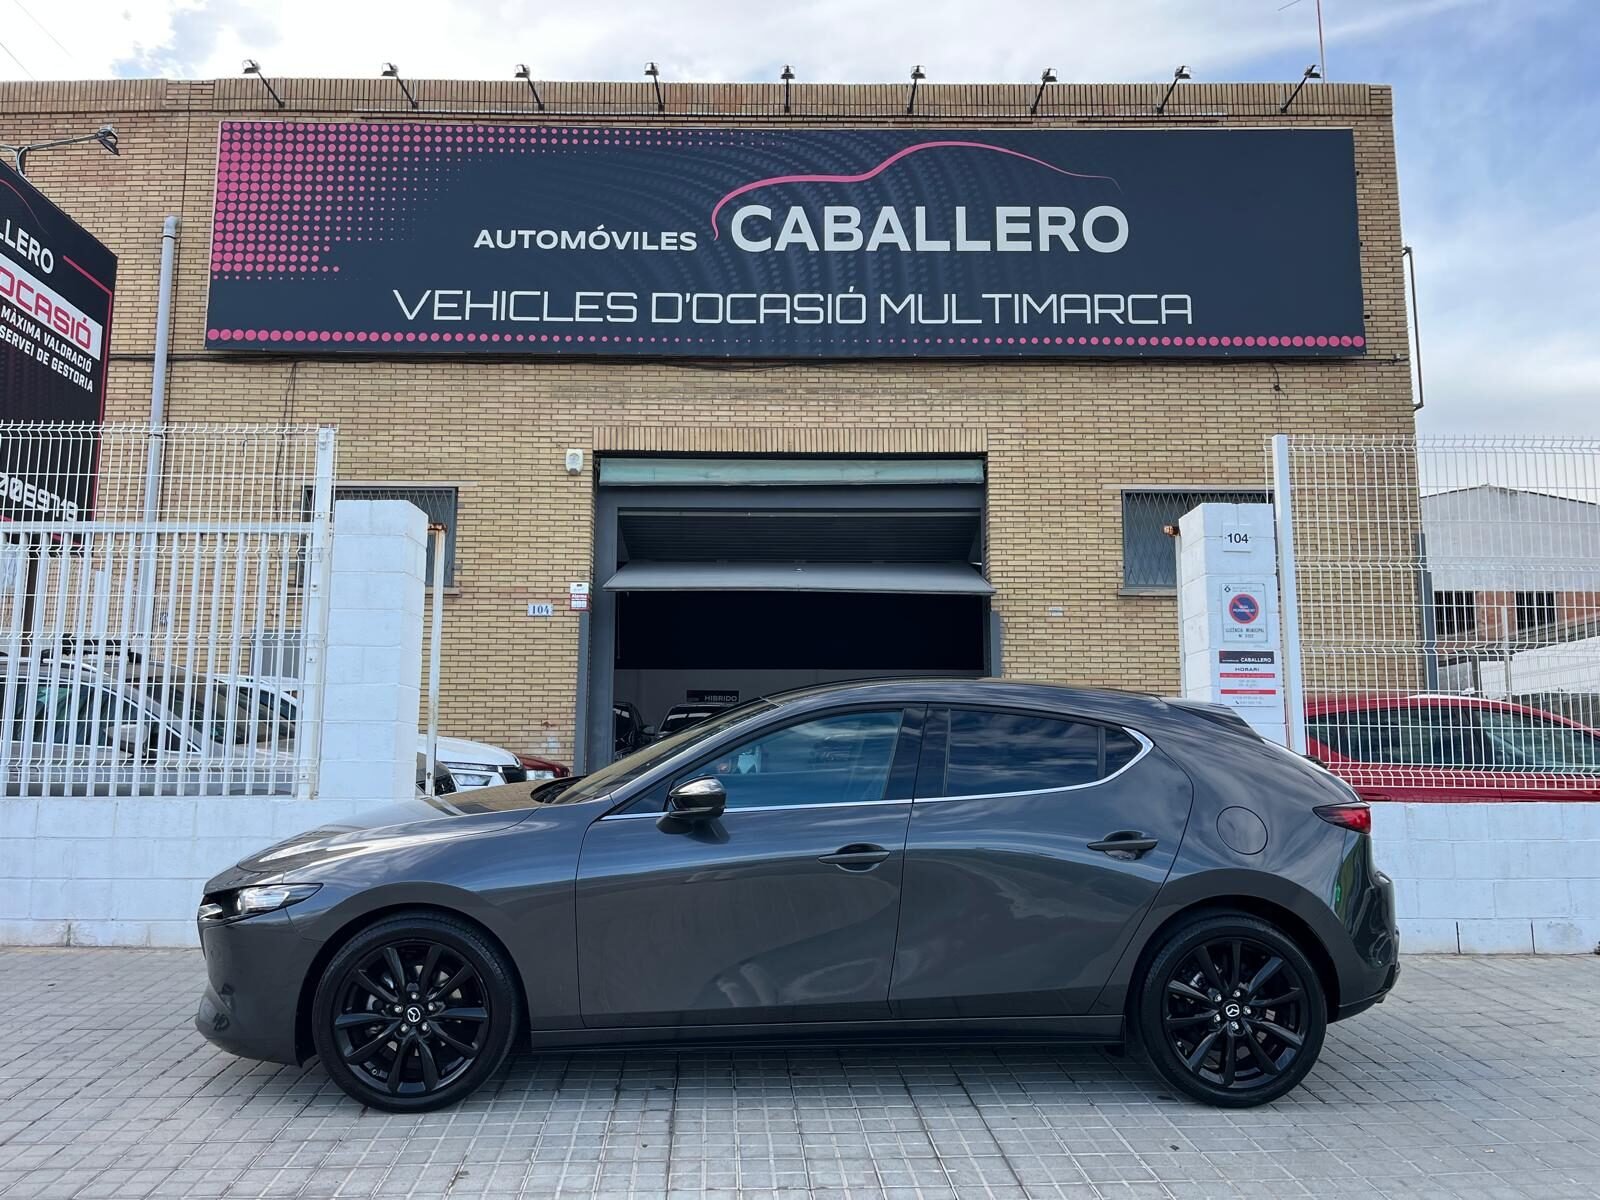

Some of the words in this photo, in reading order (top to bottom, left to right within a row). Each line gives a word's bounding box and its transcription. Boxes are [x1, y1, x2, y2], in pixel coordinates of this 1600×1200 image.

[473, 225, 698, 251] AUTOMÓVILES
[731, 204, 1130, 253] CABALLERO
[393, 289, 638, 323] VEHICLES
[651, 286, 868, 324] D'OCASIÓ
[880, 293, 1193, 325] MULTIMARCA
[0, 324, 35, 357] SERVEI
[36, 347, 51, 366] DE
[51, 356, 94, 393] GESTORIA
[1, 305, 41, 341] MÀXIMA
[44, 331, 93, 374] VALORACIÓ
[1227, 533, 1249, 544] 104
[532, 605, 550, 615] 104
